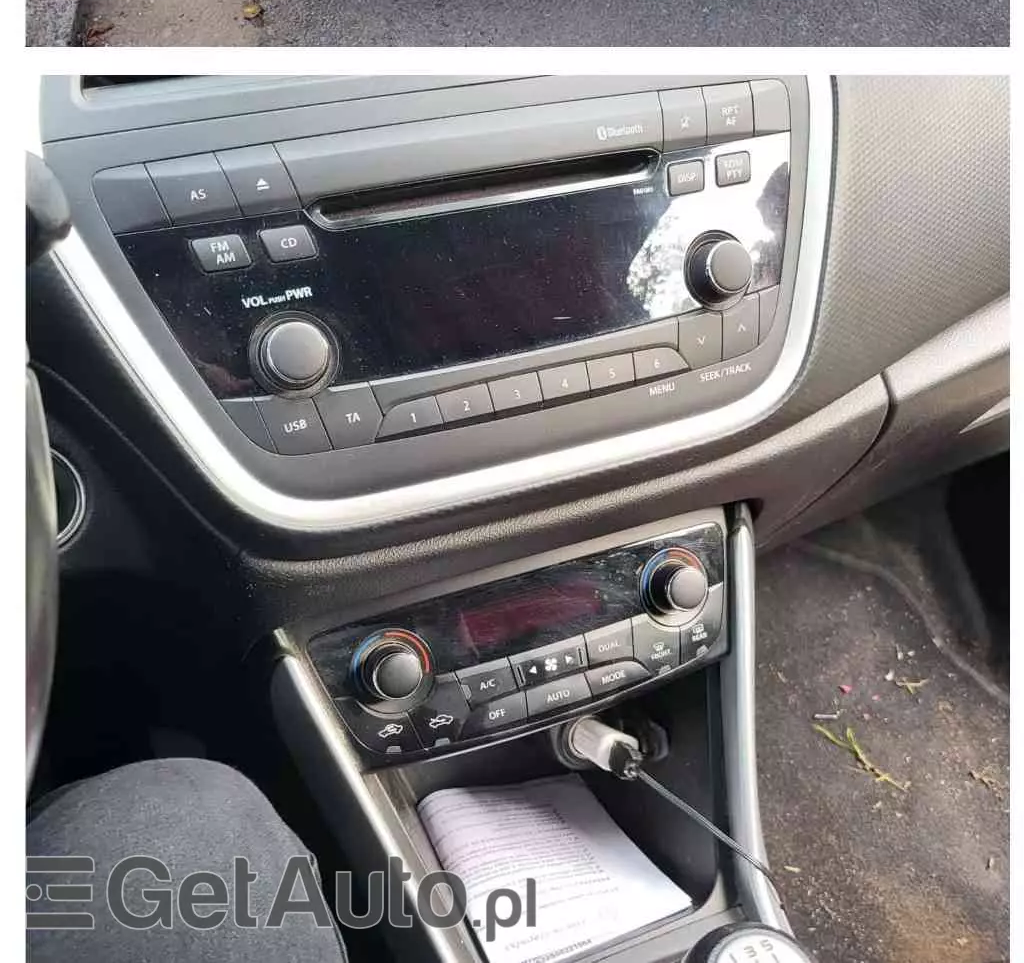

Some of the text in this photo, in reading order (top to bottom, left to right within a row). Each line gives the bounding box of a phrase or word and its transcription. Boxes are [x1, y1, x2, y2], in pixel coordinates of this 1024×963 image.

[190, 188, 207, 201] AS
[210, 241, 230, 254] FM
[280, 237, 297, 248] CD
[216, 253, 236, 265] AM
[241, 286, 313, 308] VOL PUSH PWR
[699, 364, 752, 382] SEEK/TRACK
[411, 358, 661, 423] 1 2 3 4 5 6
[649, 382, 676, 396] MENU
[345, 412, 361, 423] TA
[284, 419, 308, 433] USB
[598, 641, 621, 653] DUAL
[601, 670, 626, 685] MODE
[479, 679, 497, 690] A/C
[546, 690, 570, 703] AUTO
[488, 708, 506, 720] OFF
[744, 945, 757, 958] 3
[760, 939, 773, 951] 5
